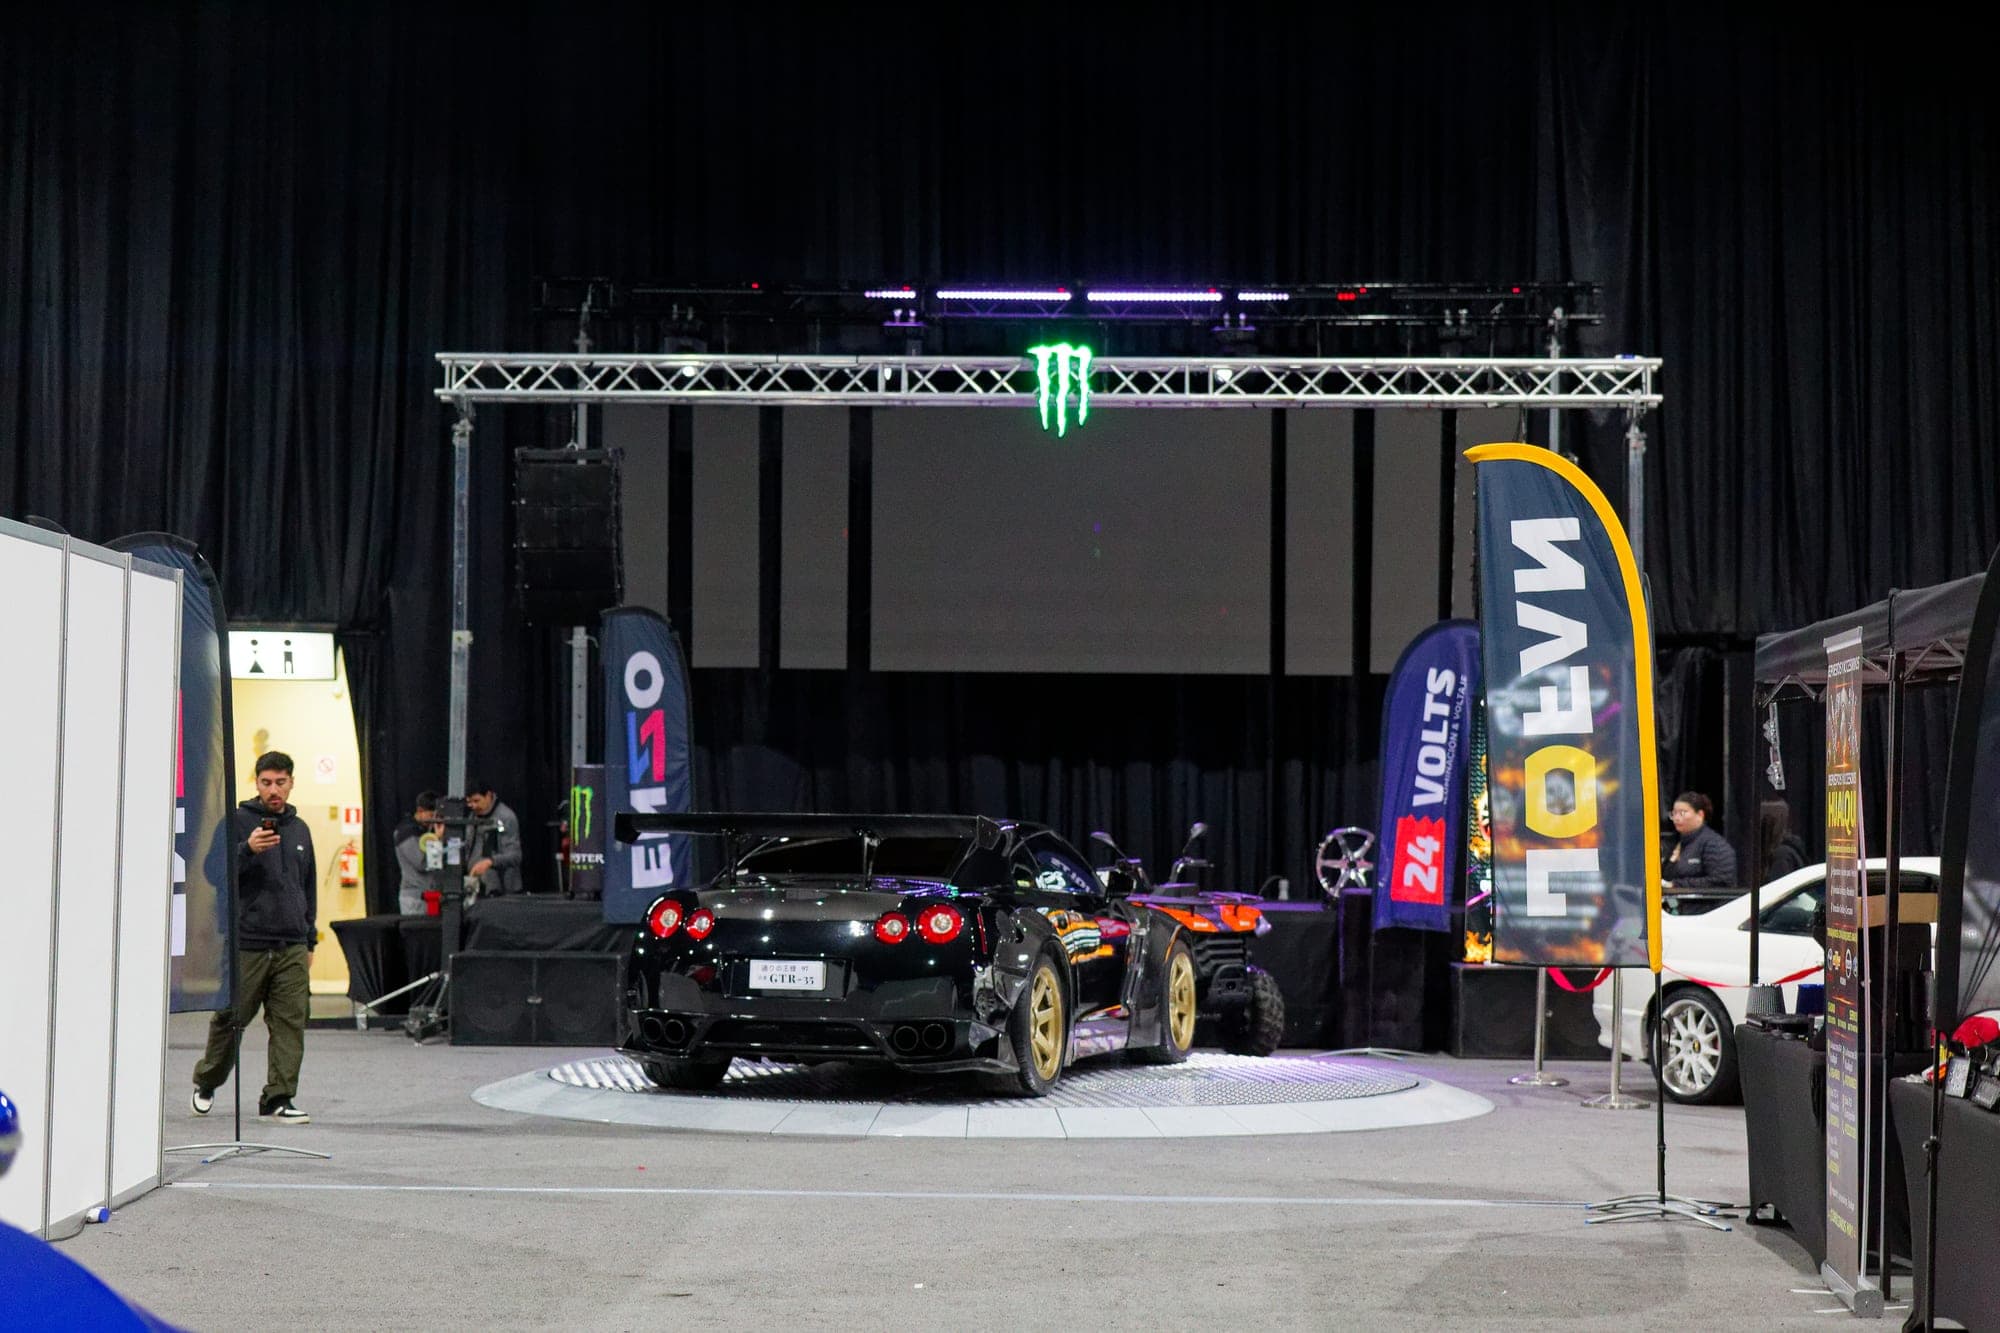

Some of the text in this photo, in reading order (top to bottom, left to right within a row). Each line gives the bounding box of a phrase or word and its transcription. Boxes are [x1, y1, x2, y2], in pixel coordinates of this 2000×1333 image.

[1453, 674, 1468, 720] VOLTAJE
[1412, 666, 1456, 808] VOLTS
[1403, 835, 1441, 894] 24
